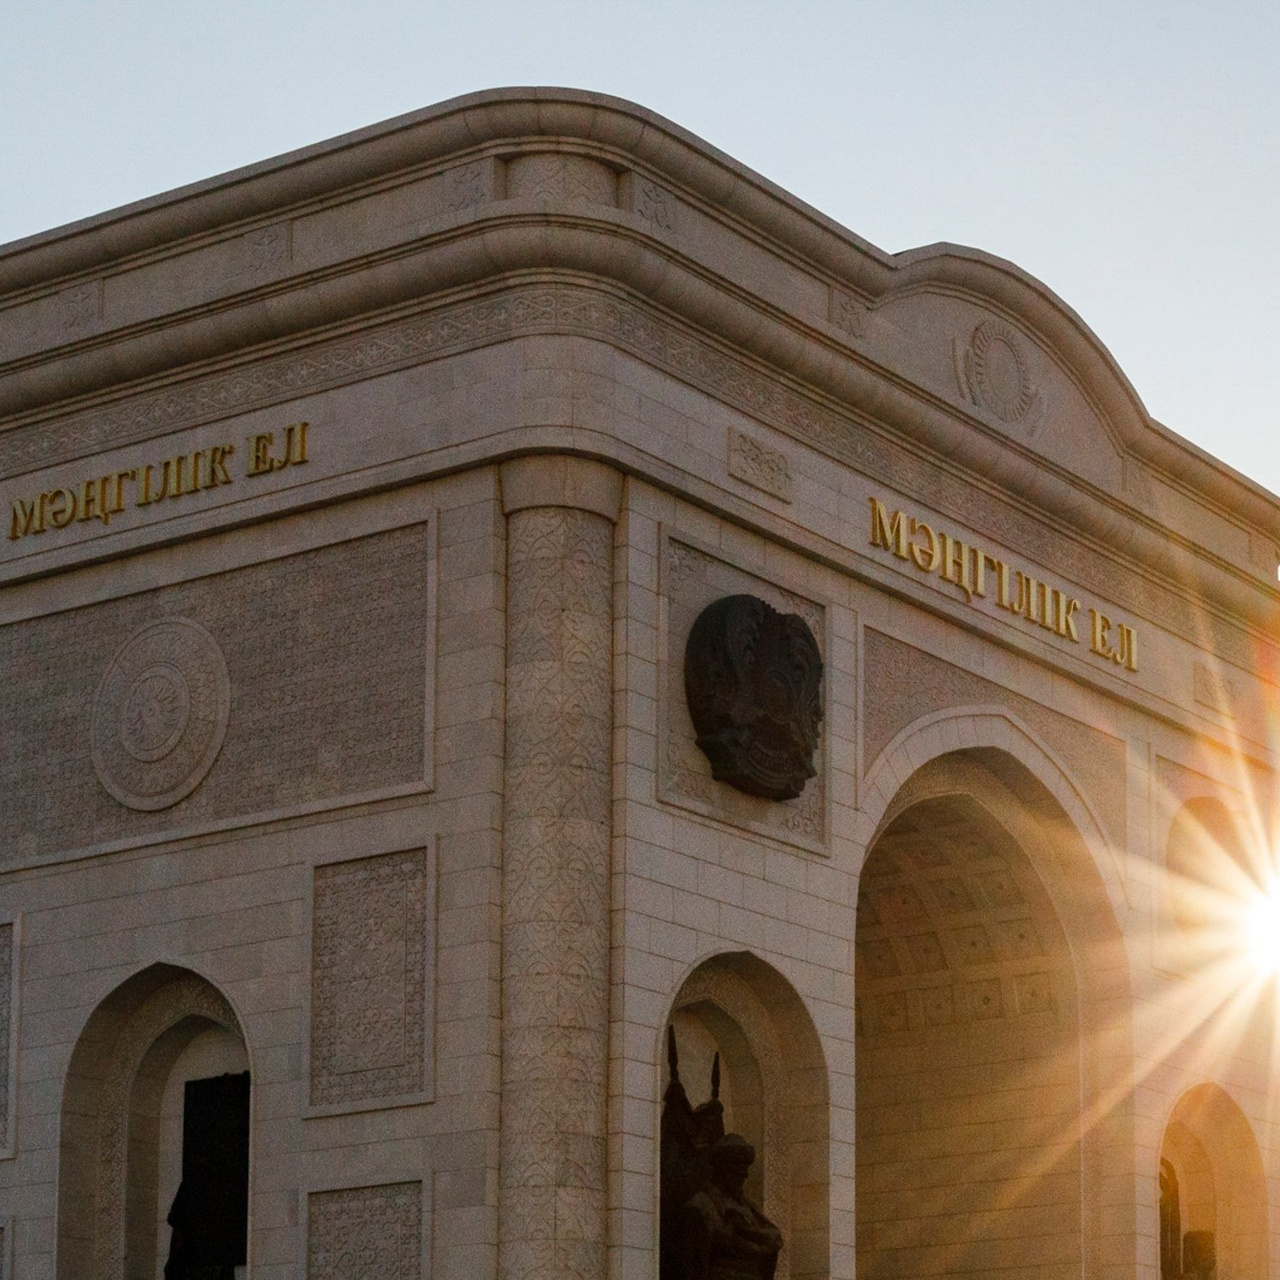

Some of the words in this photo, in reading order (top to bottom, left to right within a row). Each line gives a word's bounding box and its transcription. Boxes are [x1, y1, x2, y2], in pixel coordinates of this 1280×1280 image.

[8, 443, 234, 540] МӘҢГІЛІК
[246, 421, 309, 478] ЕЛ
[868, 496, 1080, 643] МӘҢГІЛІК
[1088, 607, 1139, 673] ЕЛ
